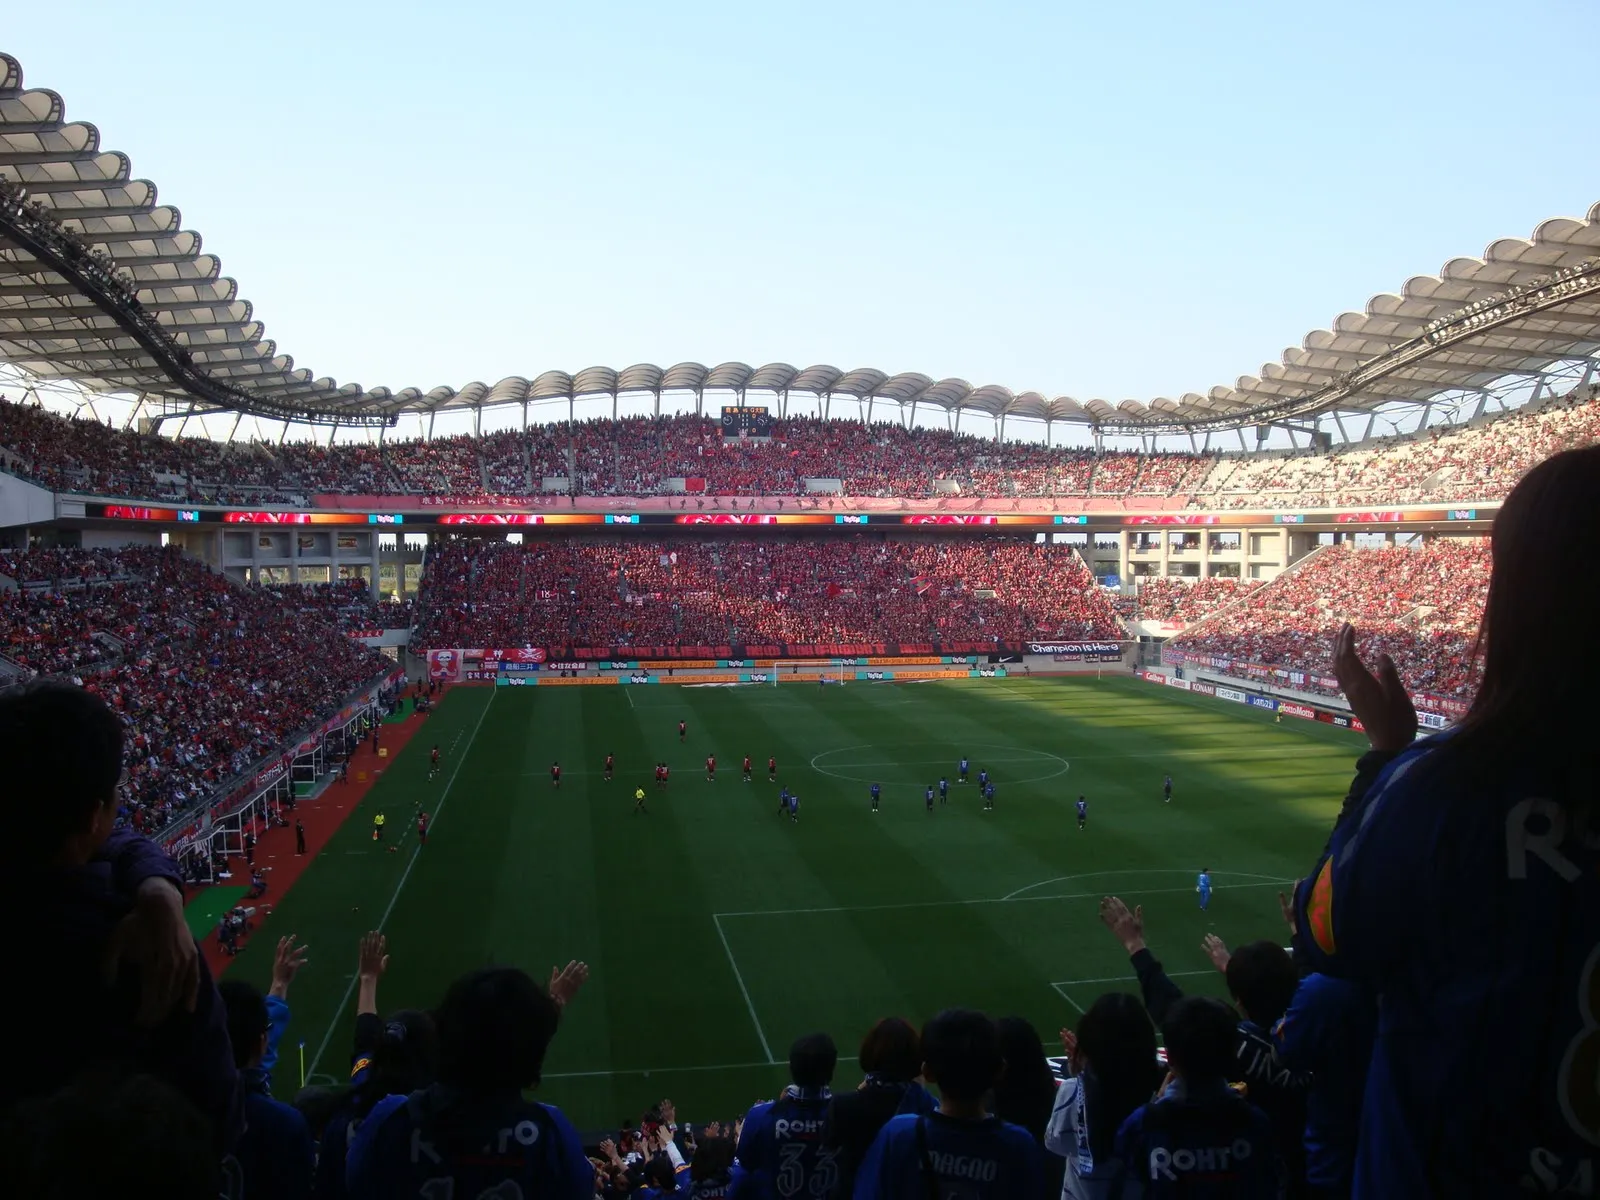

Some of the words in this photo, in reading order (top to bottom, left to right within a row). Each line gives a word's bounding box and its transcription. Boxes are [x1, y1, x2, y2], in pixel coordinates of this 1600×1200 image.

[1032, 643, 1081, 654] Champion
[1092, 642, 1119, 651] Here
[1191, 682, 1215, 695] KONAMI
[1150, 1138, 1252, 1182] ROHTO
